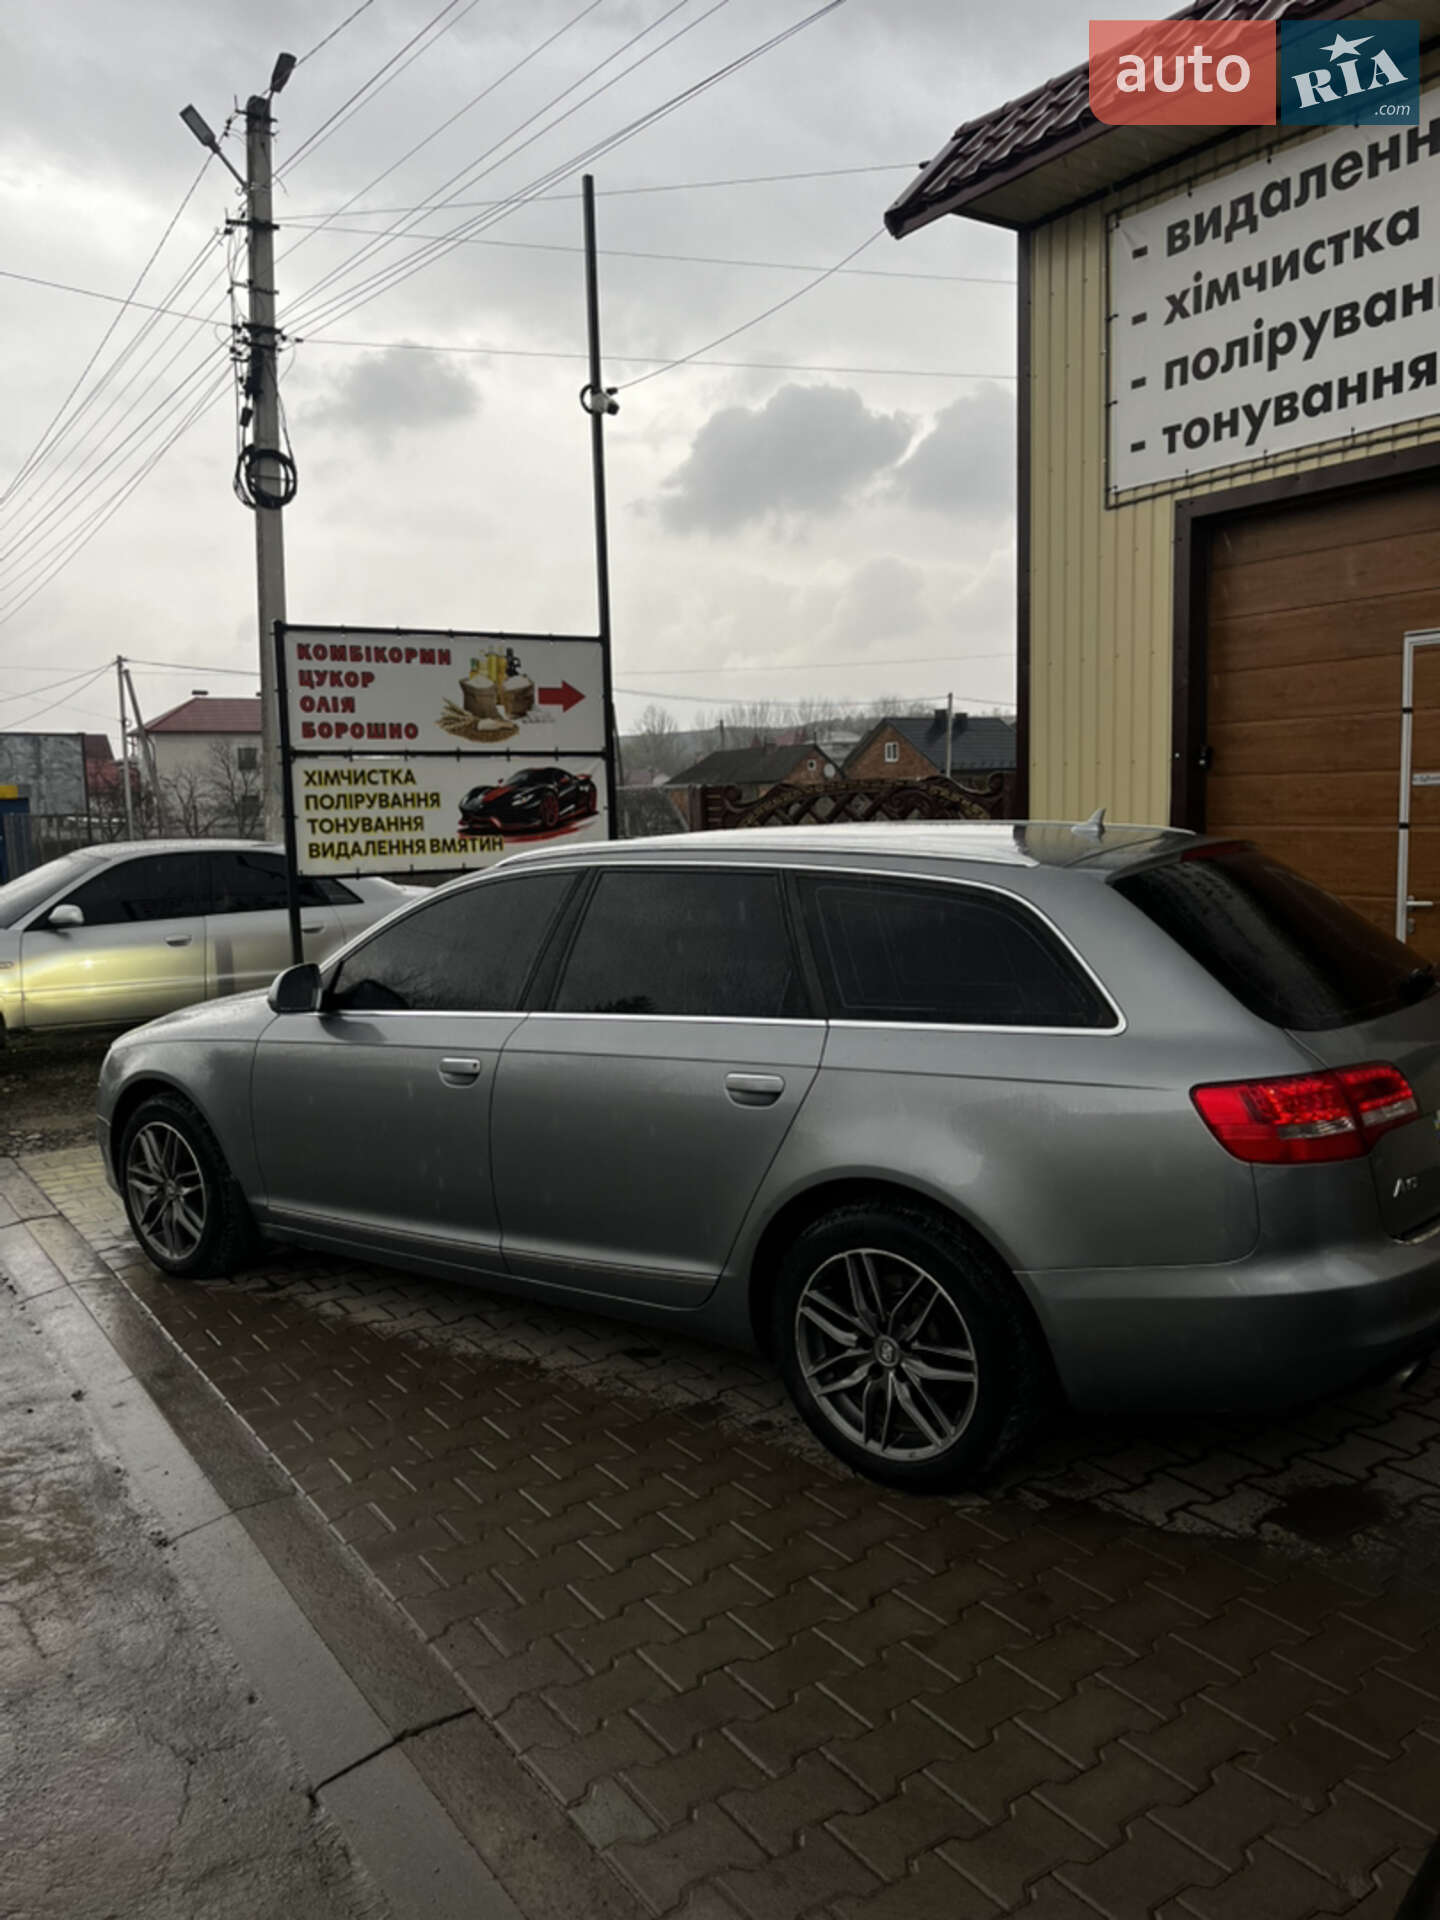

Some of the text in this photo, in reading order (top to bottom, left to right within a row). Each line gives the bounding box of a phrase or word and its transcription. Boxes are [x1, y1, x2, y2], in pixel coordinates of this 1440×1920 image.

[1164, 205, 1420, 326] хімчистка
[1164, 274, 1440, 390] поліруван
[1162, 350, 1437, 454] тонування
[297, 643, 452, 665] КОМБІКОРМИ
[298, 669, 375, 689] ЦУКОР
[300, 695, 355, 713] ОЛІЯ
[301, 721, 419, 739] БОРОШНО
[303, 769, 416, 787] ХІМЧИСТКА
[304, 792, 441, 811] ПОЛІРУВАННЯ
[307, 816, 424, 835] ТОНУВАННЯ
[308, 837, 504, 860] ВИДАЛЕННЯ ВМЯТИН
